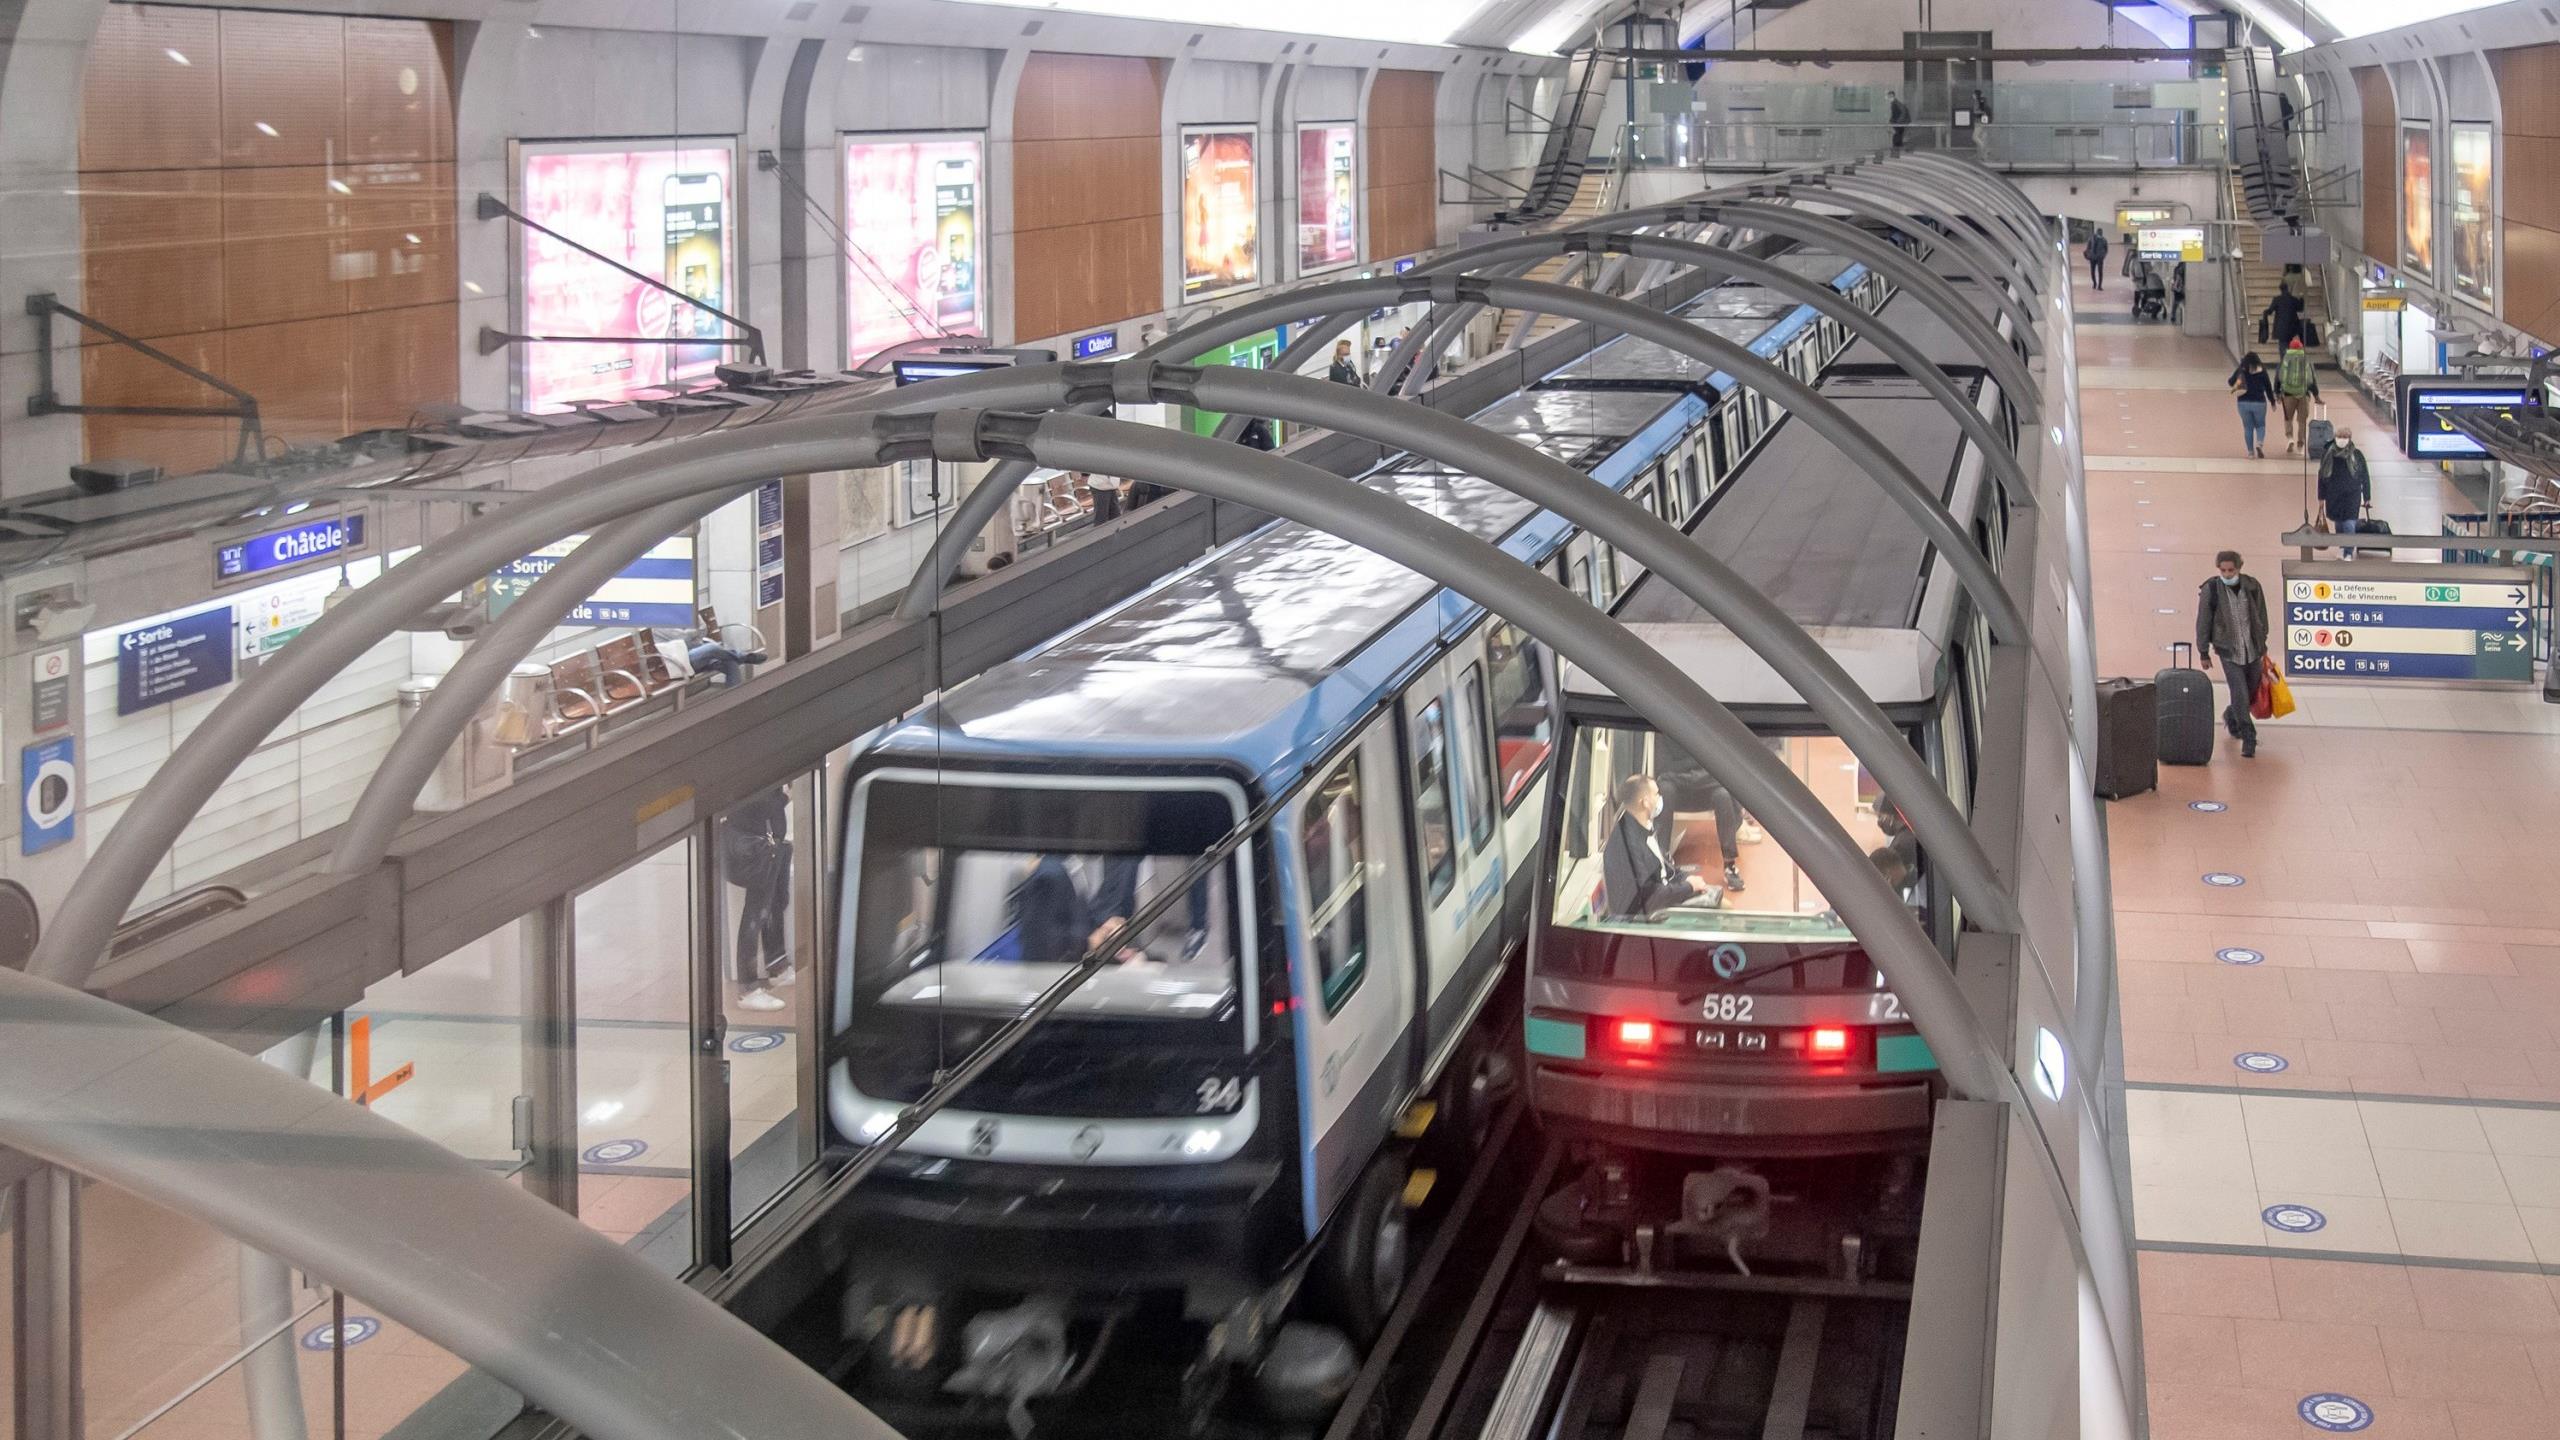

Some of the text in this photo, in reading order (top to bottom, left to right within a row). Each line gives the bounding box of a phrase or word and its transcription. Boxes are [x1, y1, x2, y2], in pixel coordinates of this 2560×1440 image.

[274, 527, 349, 560] Châtele
[2294, 607, 2344, 622] Sortie
[138, 625, 173, 646] Sortie
[2294, 655, 2346, 670] Sortie
[1702, 993, 1754, 1022] 582
[1195, 1076, 1242, 1113] 34
